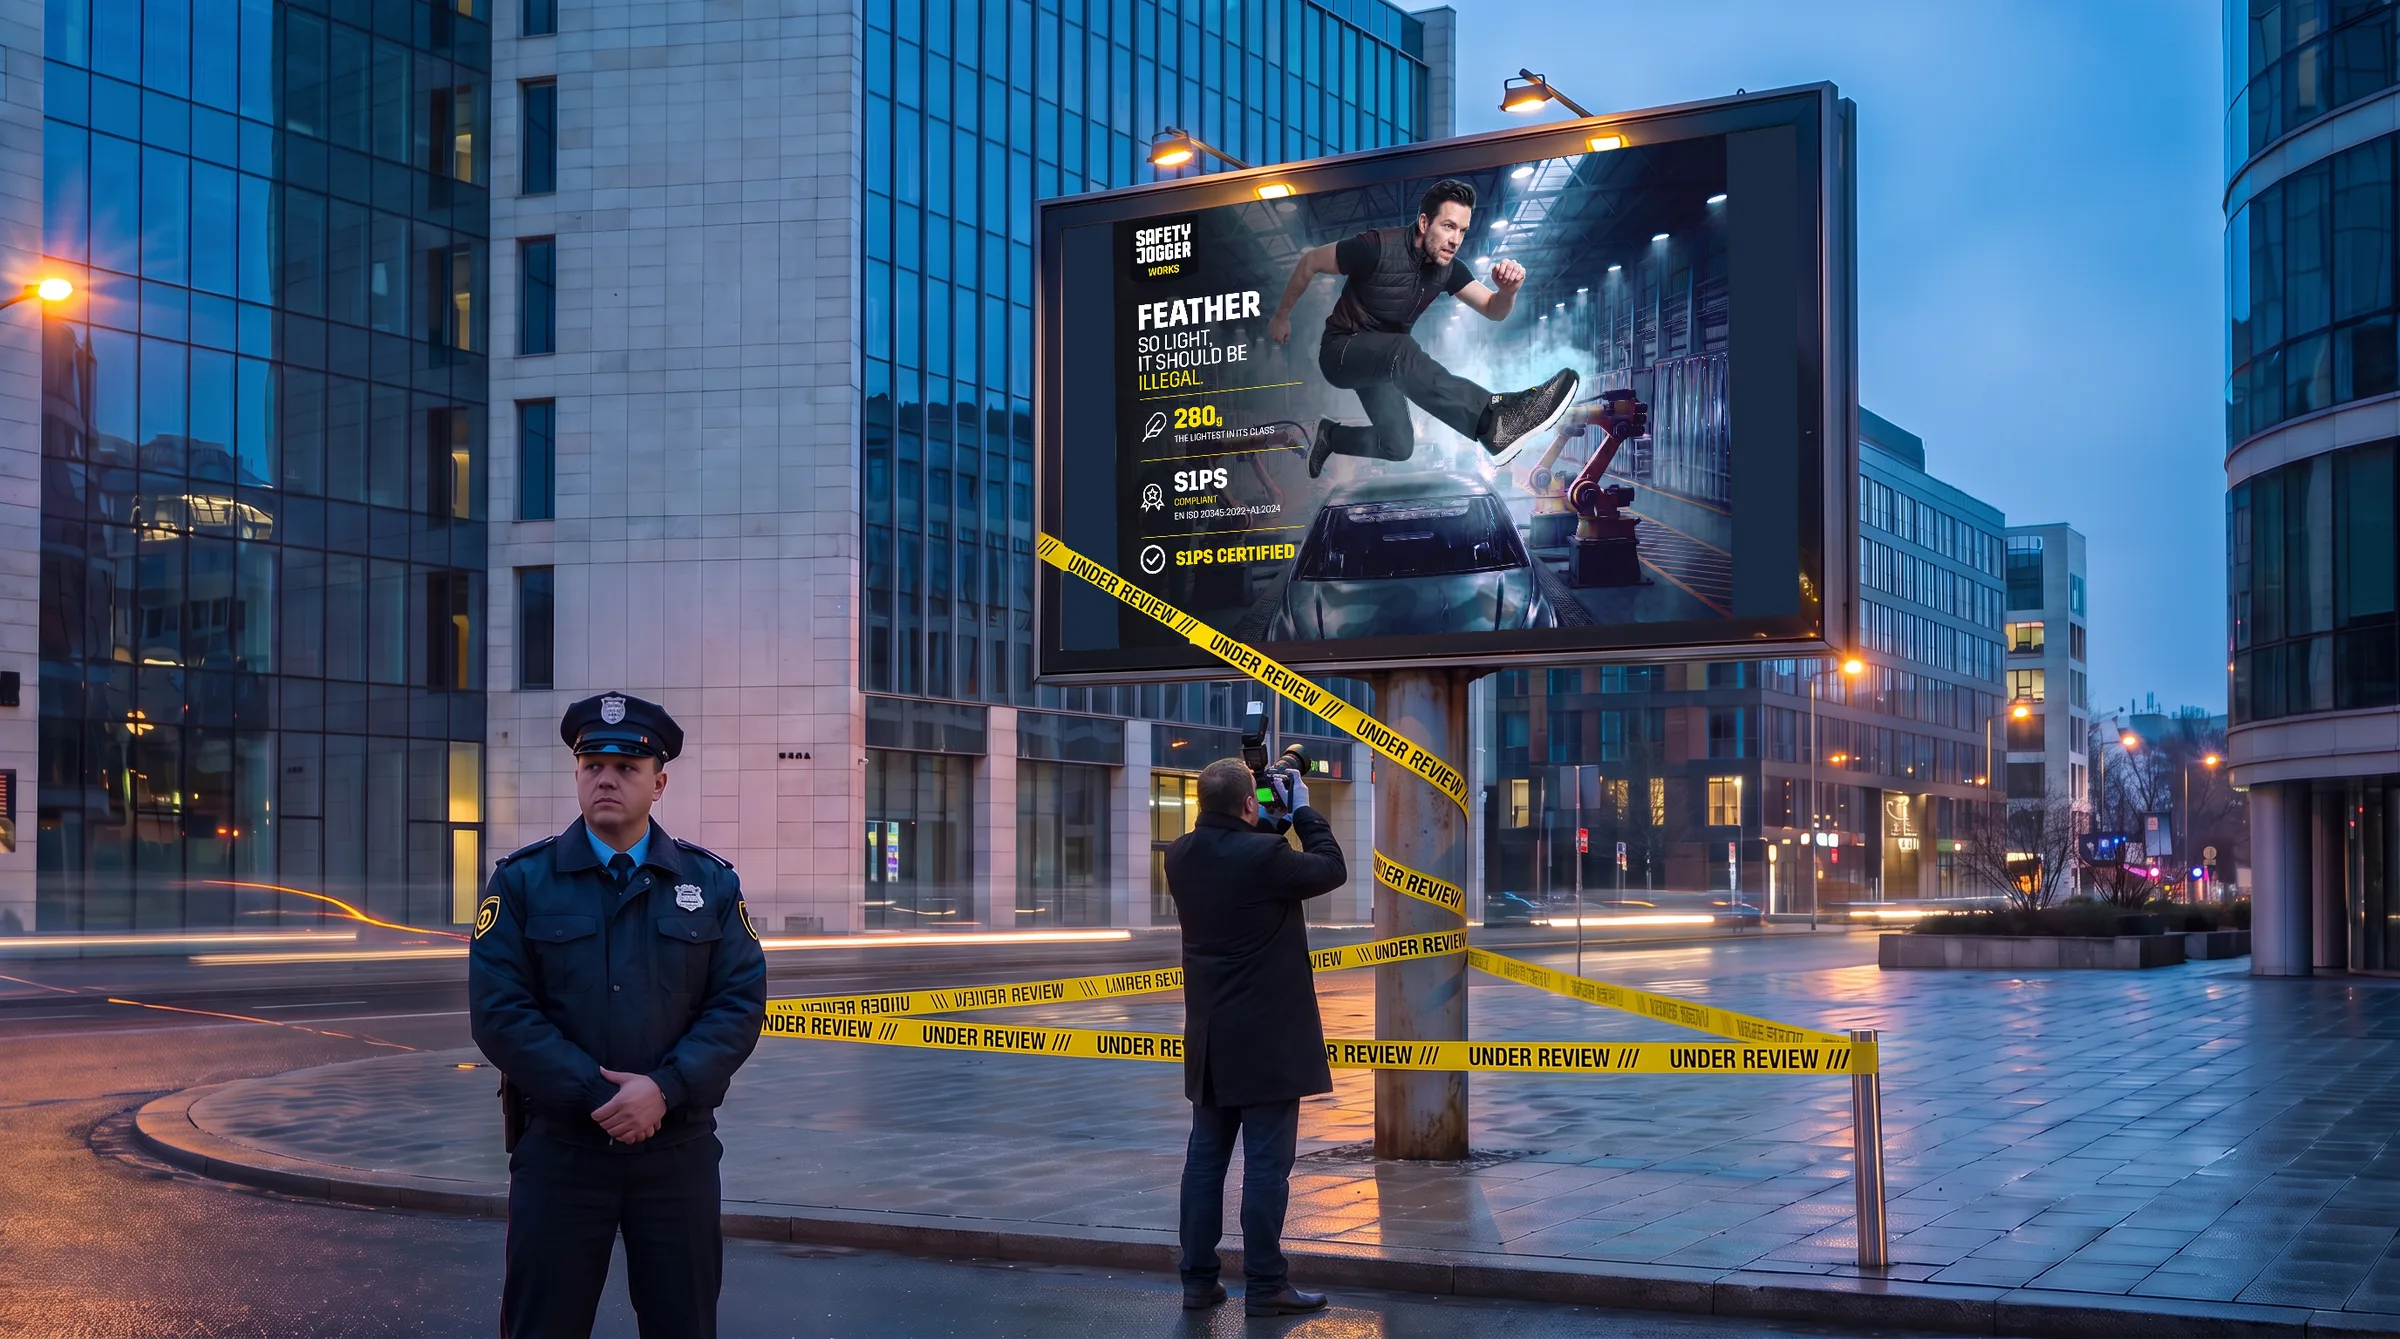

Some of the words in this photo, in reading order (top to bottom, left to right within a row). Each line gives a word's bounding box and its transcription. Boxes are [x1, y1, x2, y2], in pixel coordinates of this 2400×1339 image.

[1136, 223, 1192, 247] SAFETY
[1136, 241, 1192, 264] JOGGER
[1148, 264, 1180, 277] WORKS
[1138, 290, 1261, 331] FEATHER
[1138, 335, 1160, 353] SO
[1164, 329, 1213, 349] LIGHT,
[1138, 355, 1152, 372] IT
[1155, 347, 1221, 370] SHOULD
[1227, 344, 1248, 363] BE
[1138, 369, 1204, 391] ILLEGAL.
[1174, 433, 1189, 443] THE
[1190, 430, 1226, 442] LIGHTEST
[1226, 429, 1235, 438] IN
[1236, 428, 1248, 438] ITS
[1249, 425, 1275, 436] CLASS
[1174, 467, 1228, 492] S1PS
[1174, 495, 1218, 506] COMPLIANT
[1174, 511, 1185, 520] EN
[1186, 510, 1199, 520] ISO
[1175, 549, 1214, 566] S1PS
[1217, 543, 1295, 564] CERTIFIED
[1067, 554, 1120, 594] UNDER
[1119, 583, 1178, 624] REVIEW
[1209, 634, 1263, 674] UNDER
[1261, 663, 1322, 707] REVIEW
[1356, 718, 1410, 760] UNDER
[1408, 750, 1463, 796] REVIEW
[1310, 950, 1342, 969] VIEW
[1374, 939, 1419, 961] UNDER
[1011, 983, 1064, 1003] REVIEW
[763, 1013, 806, 1034] NDER
[811, 1017, 873, 1039] REVIEW
[922, 1025, 978, 1046] UNDER
[983, 1029, 1047, 1050] REVIEW
[1097, 1035, 1155, 1056] UNDER
[1344, 1044, 1413, 1064] REVIEW
[1468, 1047, 1532, 1067] UNDER
[1538, 1048, 1610, 1069] REVIEW
[1670, 1048, 1736, 1069] UNDER
[1743, 1048, 1819, 1069] REVIEW
